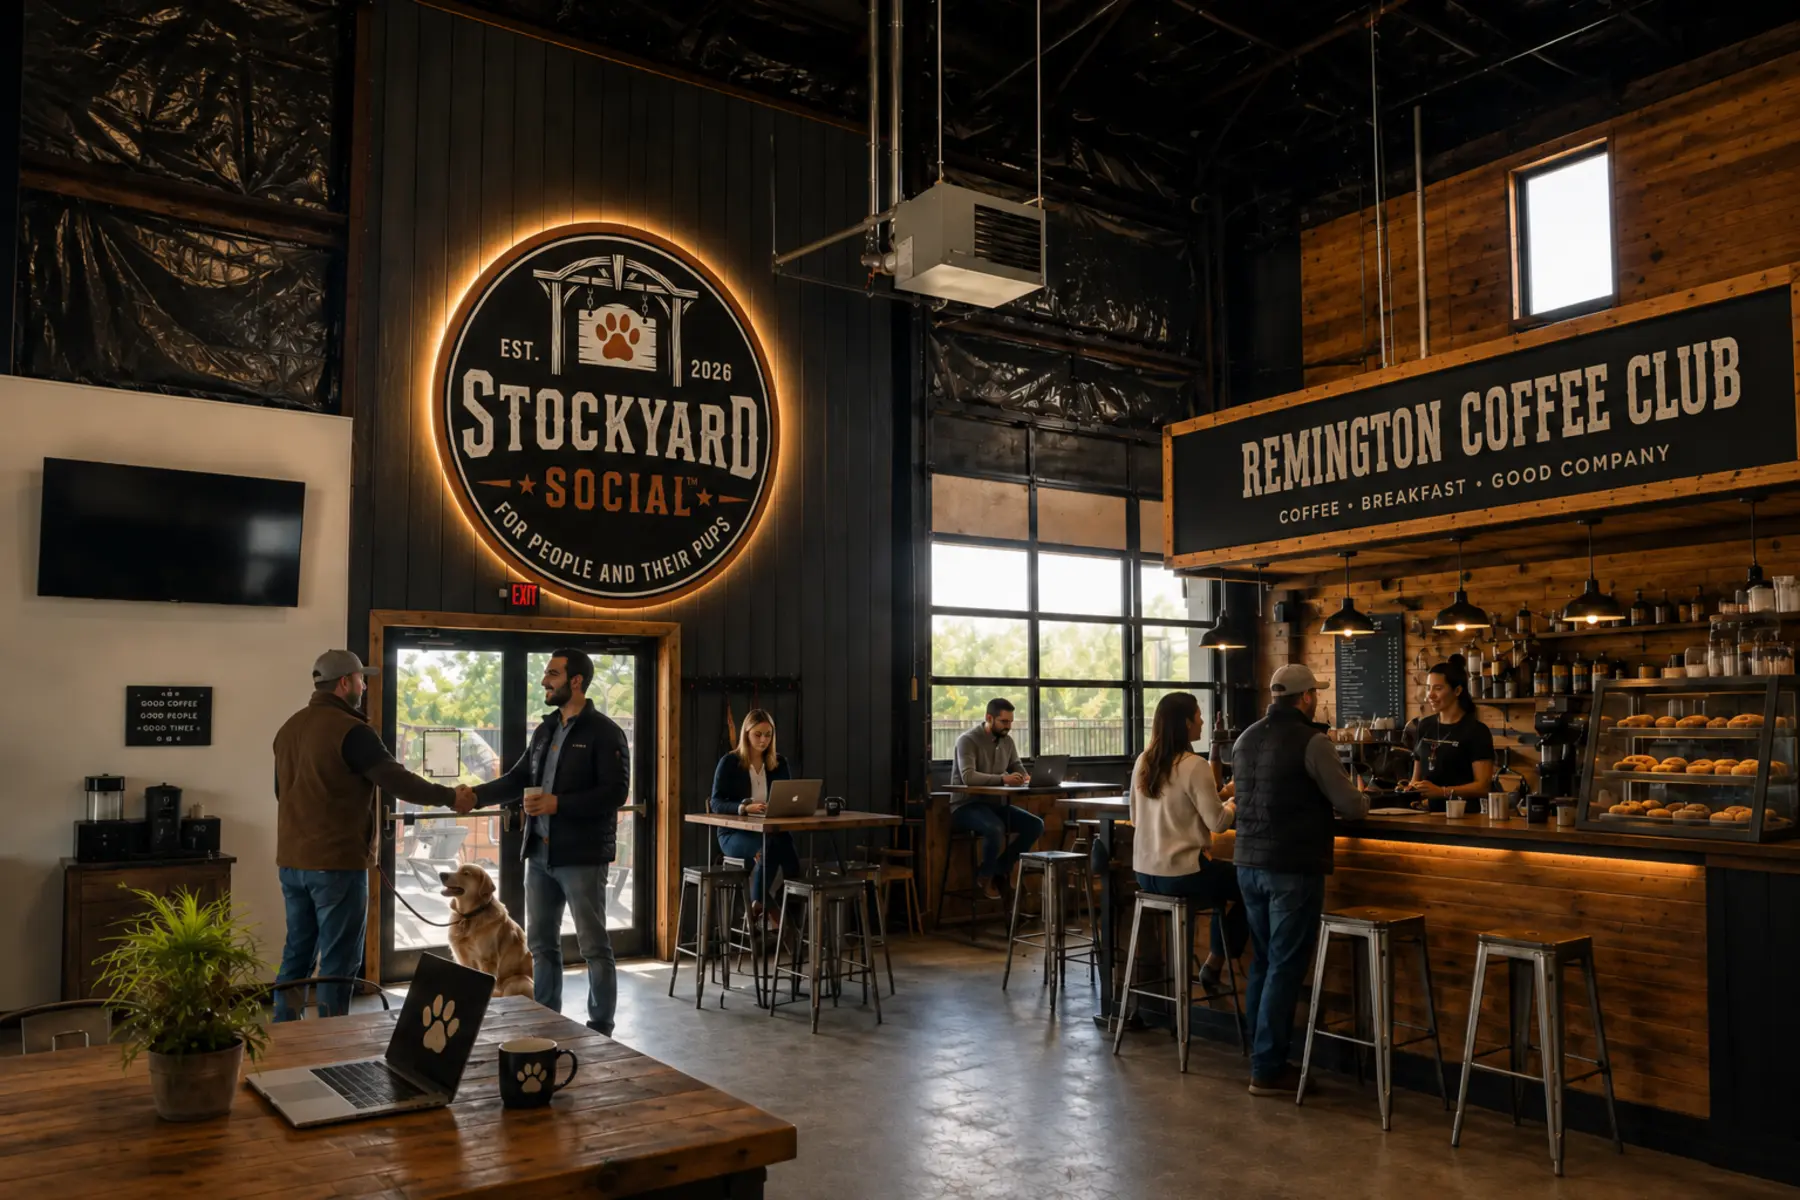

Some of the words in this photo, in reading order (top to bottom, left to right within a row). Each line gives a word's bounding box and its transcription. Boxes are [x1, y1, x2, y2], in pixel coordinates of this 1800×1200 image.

[501, 339, 539, 361] EST.
[692, 360, 731, 381] 2026
[462, 368, 758, 480] STOCKYARD
[1241, 400, 1443, 499] REMINGTON
[1459, 362, 1610, 458] COFFEE
[1626, 336, 1741, 425] CLUB
[1279, 501, 1340, 524] COFFEE
[1361, 478, 1467, 511] BREAKFAST
[1491, 464, 1552, 489] GOOD
[1560, 443, 1671, 478] COMPANY
[493, 501, 528, 540] FOR
[527, 533, 594, 579] PEOPLE
[600, 563, 635, 584] AND
[641, 550, 692, 582] THEIR
[692, 516, 731, 559] PUPS
[512, 584, 537, 606] EXIT
